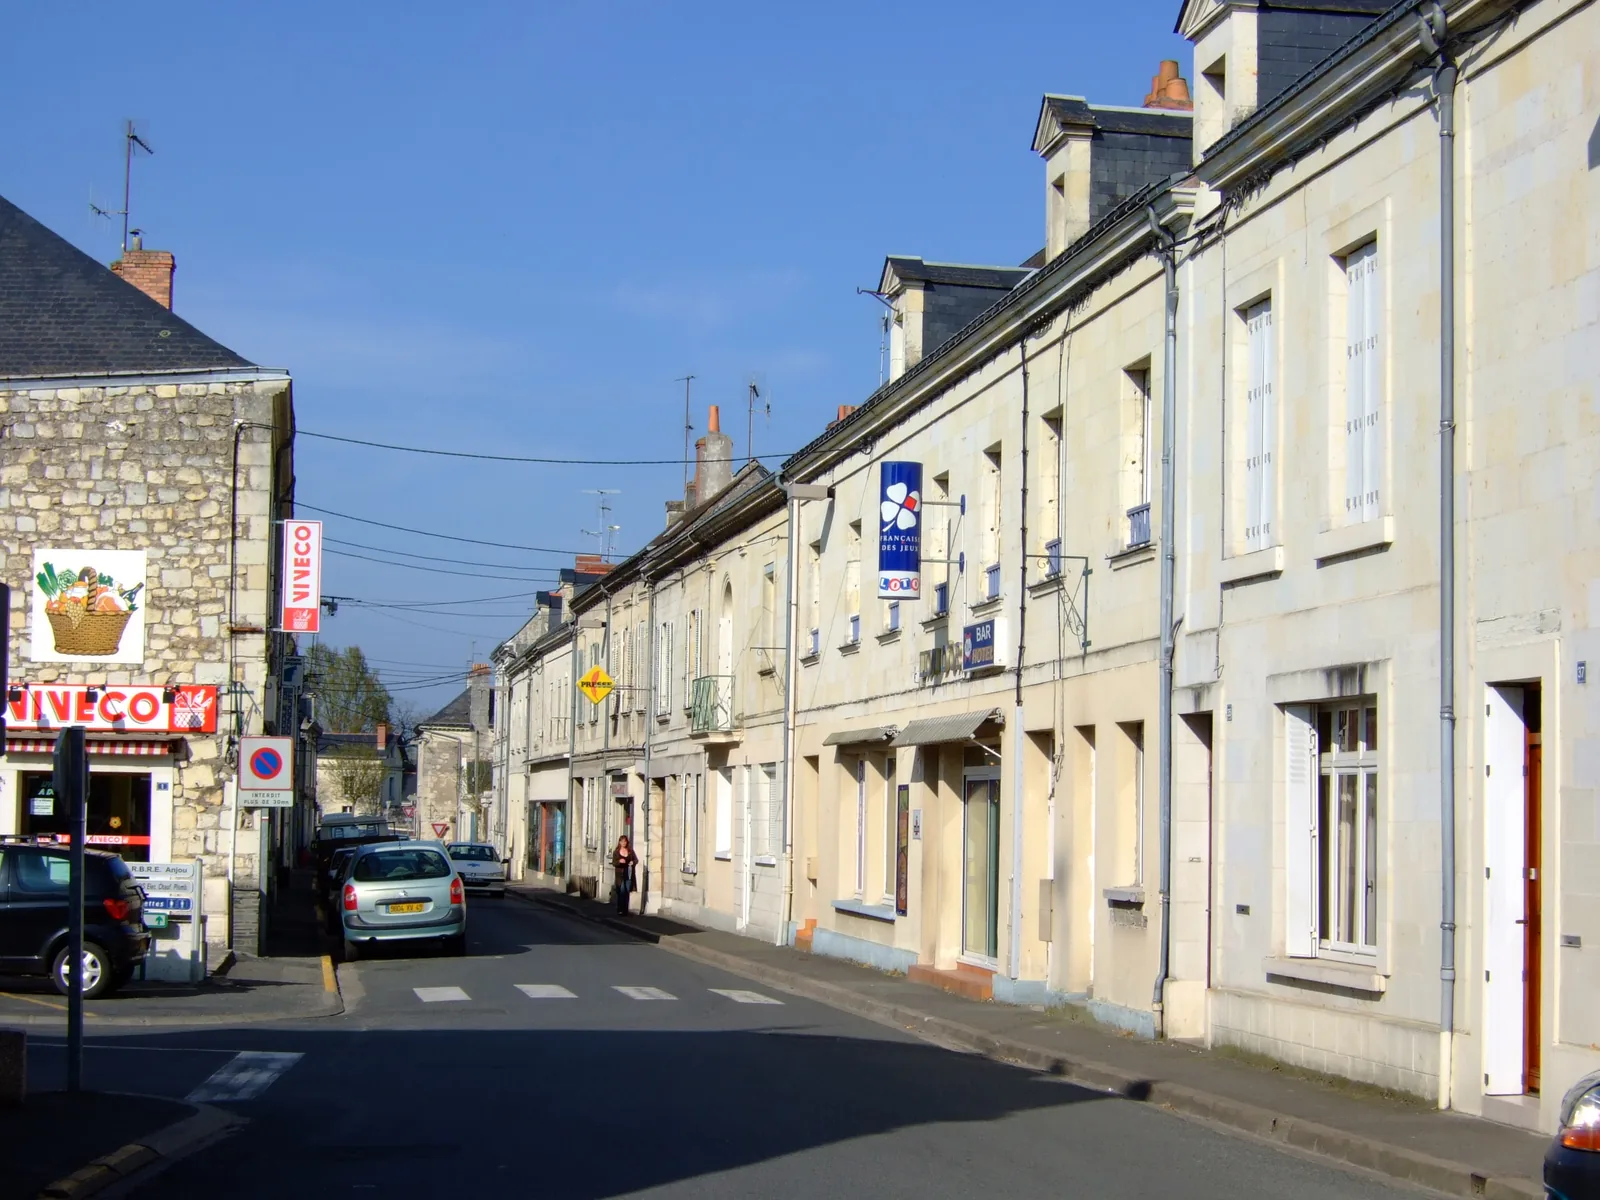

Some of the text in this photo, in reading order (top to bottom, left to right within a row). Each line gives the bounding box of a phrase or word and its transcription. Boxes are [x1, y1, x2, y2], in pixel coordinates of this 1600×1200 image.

[293, 525, 311, 602] VIVECO
[880, 577, 919, 592] LOTO
[976, 624, 992, 642] BAR
[1577, 666, 1585, 679] 37
[7, 691, 160, 723] VIVECO
